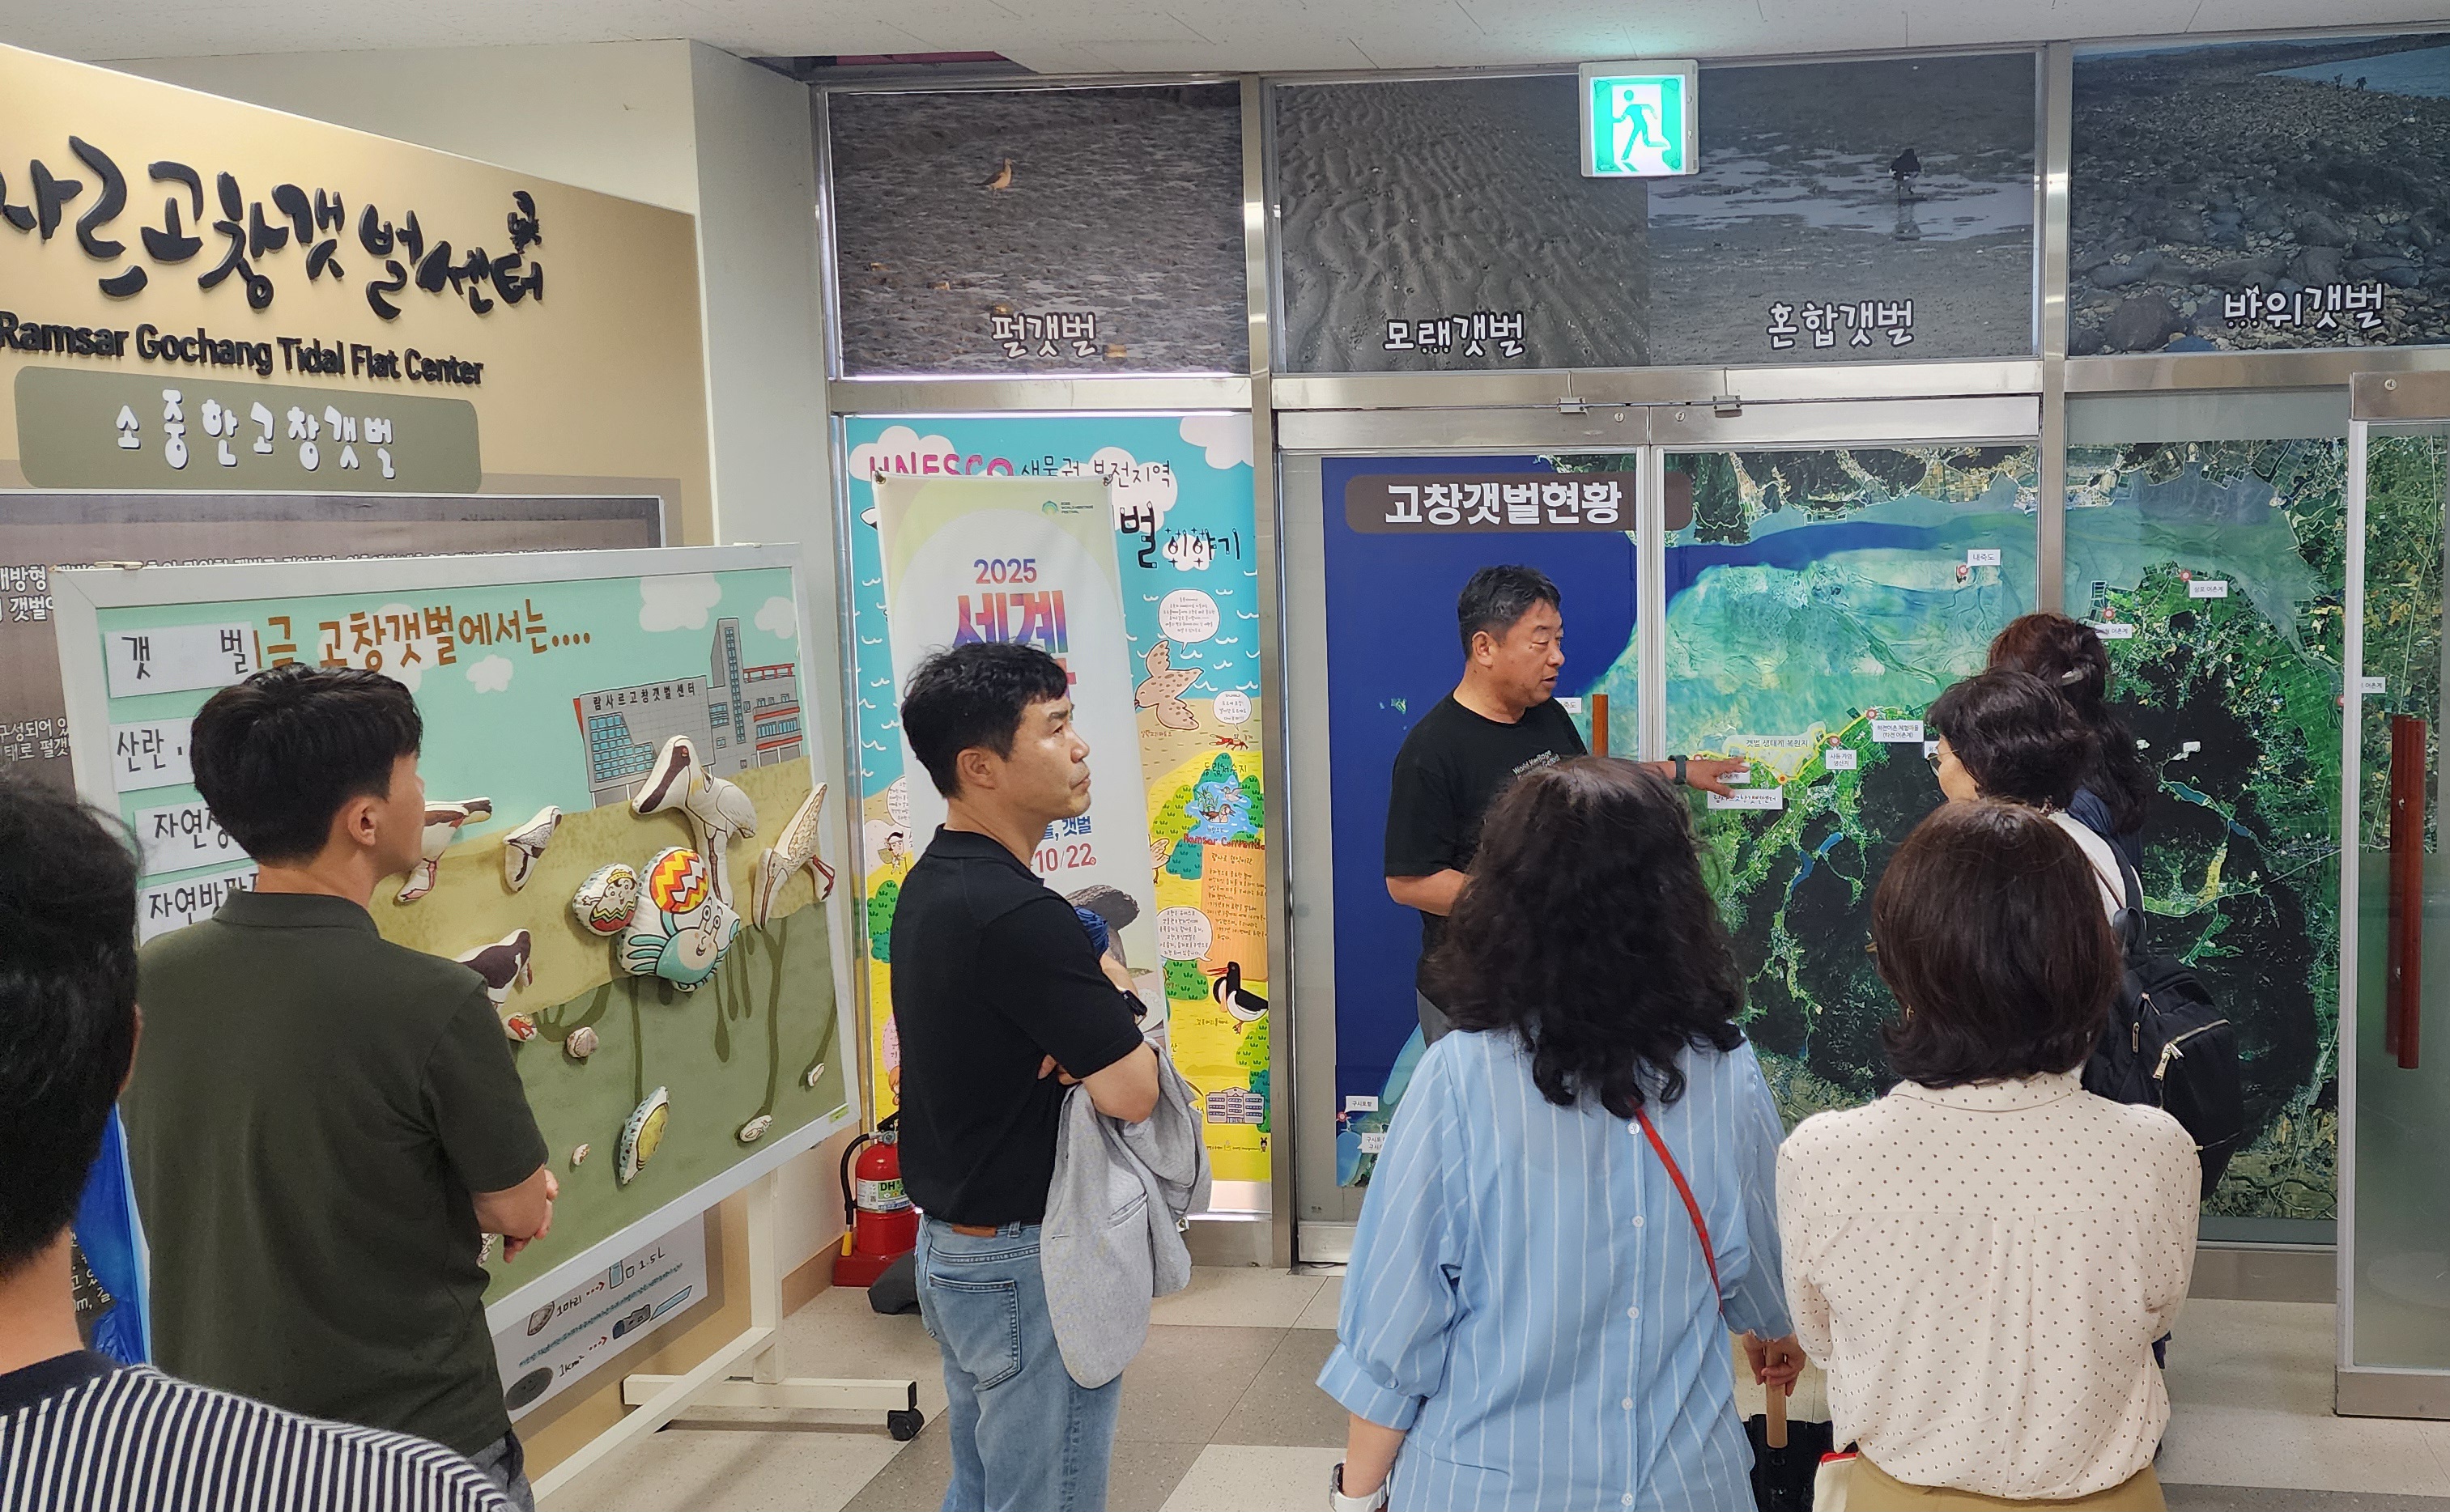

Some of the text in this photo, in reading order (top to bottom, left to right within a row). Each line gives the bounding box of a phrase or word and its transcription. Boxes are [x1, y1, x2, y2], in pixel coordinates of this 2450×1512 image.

[1768, 300, 1914, 349] 혼합갯벌
[2223, 282, 2383, 329] 바위갯벌
[0, 309, 484, 387] Ramsar Gochang Tidal Flat Center
[991, 313, 1096, 358] 펄갯벌
[1383, 313, 1525, 358] 모래갯벌
[1385, 482, 1622, 525] 고창갯벌현황
[1168, 528, 1240, 562] 이야기
[974, 559, 1036, 584] 2025
[952, 590, 1068, 653] 세계
[39, 737, 70, 759] 펄갯
[1205, 762, 1248, 777] 동림저수지
[1062, 816, 1091, 837] 갯벌
[880, 1181, 895, 1191] DH
